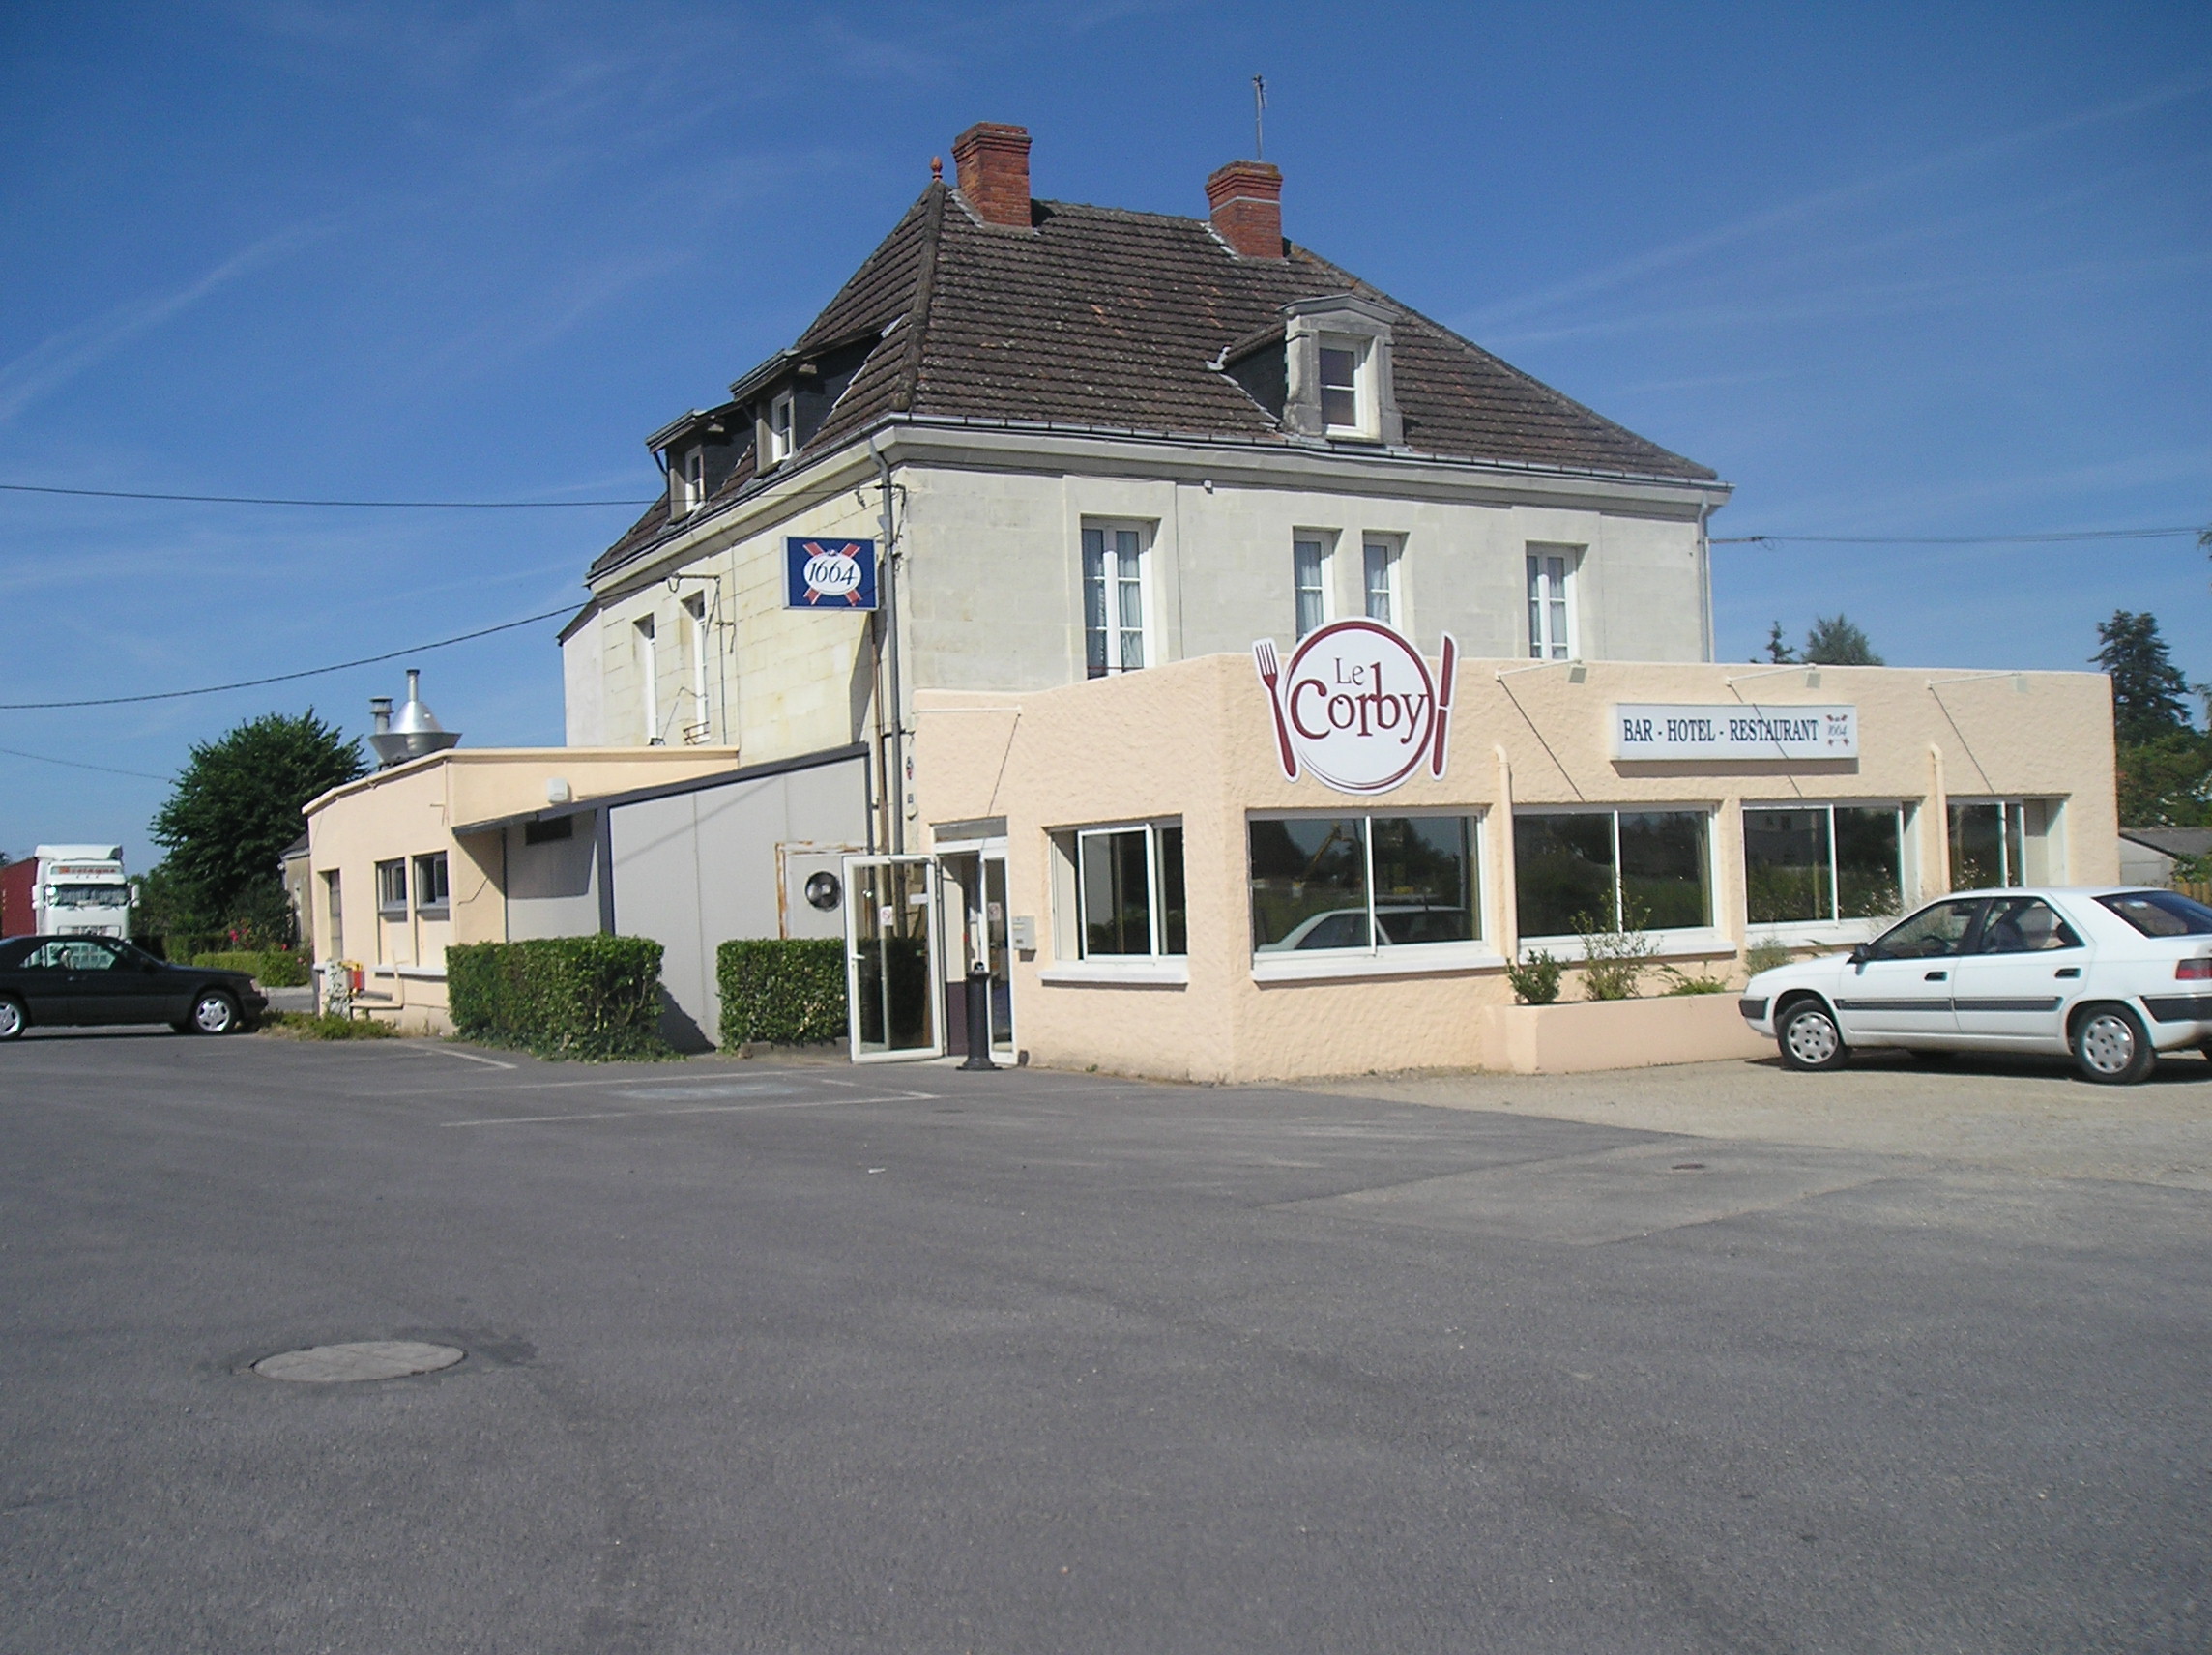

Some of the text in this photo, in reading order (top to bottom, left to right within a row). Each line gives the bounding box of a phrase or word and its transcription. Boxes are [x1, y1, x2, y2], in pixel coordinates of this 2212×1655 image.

[808, 559, 859, 586] 1664
[1333, 657, 1364, 686] Le
[1290, 661, 1430, 745] Corby
[1623, 718, 1654, 742] BAR
[1667, 718, 1716, 742] HOTEL
[1729, 718, 1819, 742] RESTAURANT
